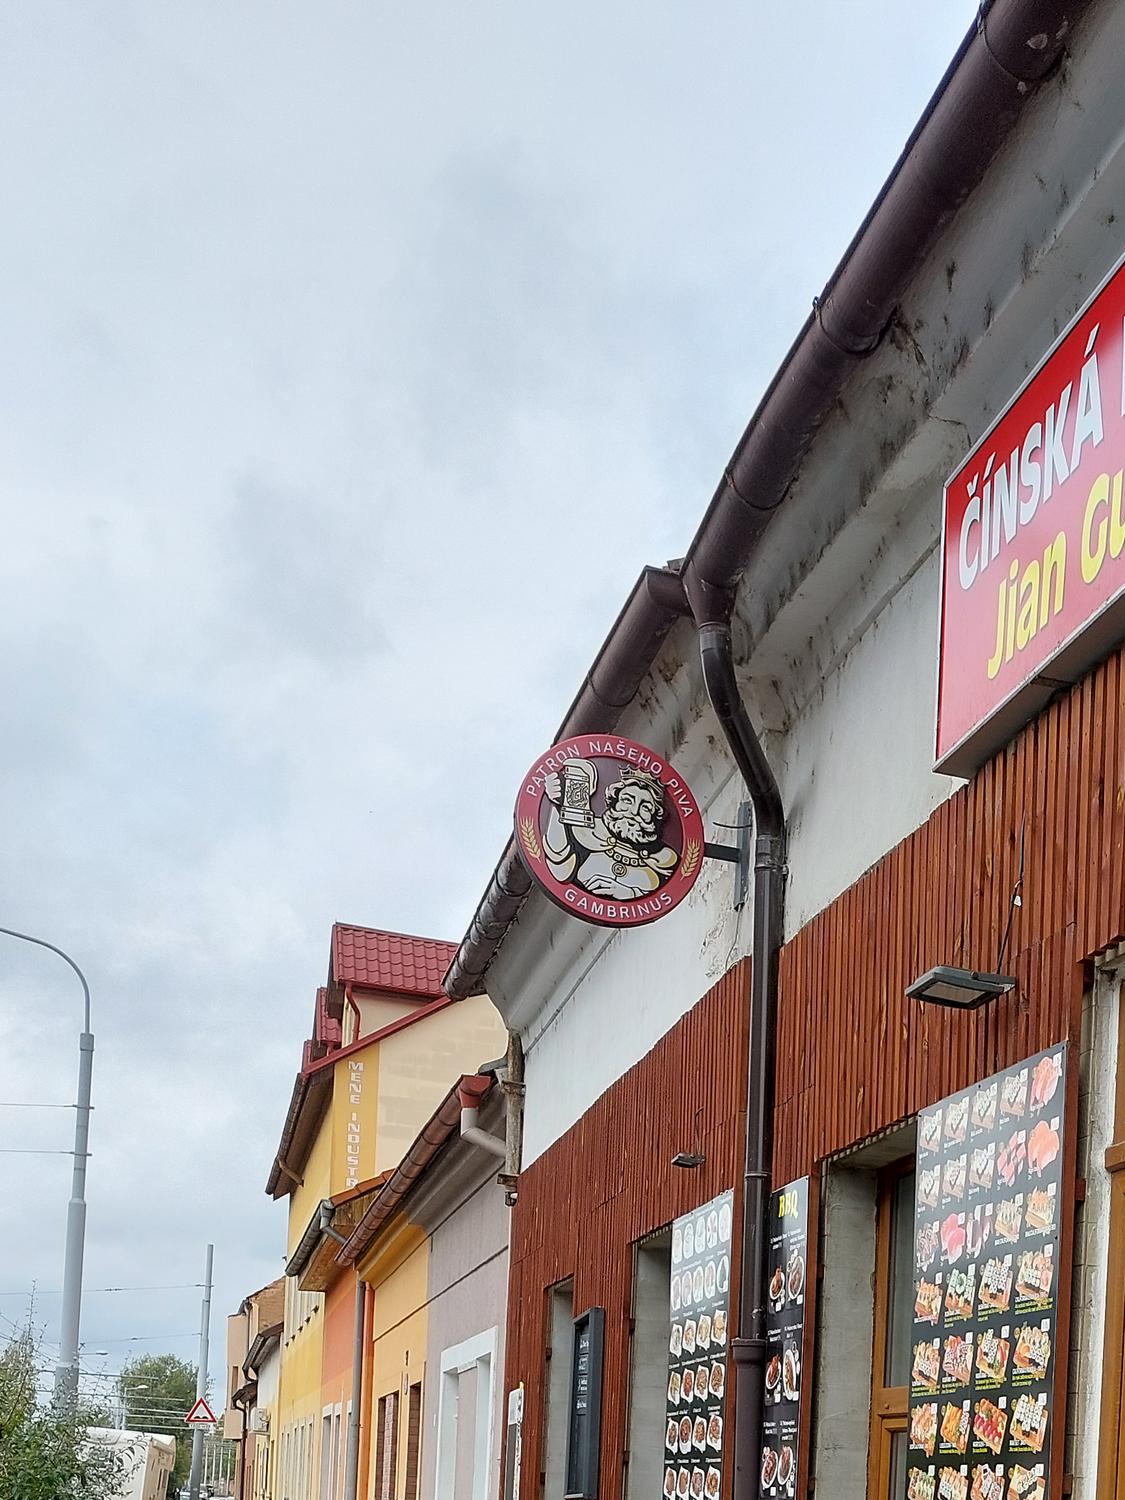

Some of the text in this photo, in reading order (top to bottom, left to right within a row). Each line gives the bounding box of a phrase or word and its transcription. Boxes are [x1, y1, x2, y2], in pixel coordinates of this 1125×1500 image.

[958, 322, 1105, 590] ČÍNSKÁ
[986, 531, 1067, 680] Jian
[526, 739, 694, 819] PATRON NAŠEHO PIVA
[564, 887, 673, 920] GAMBRINUS
[348, 1061, 364, 1104] MENE
[778, 1189, 799, 1219] BBQ
